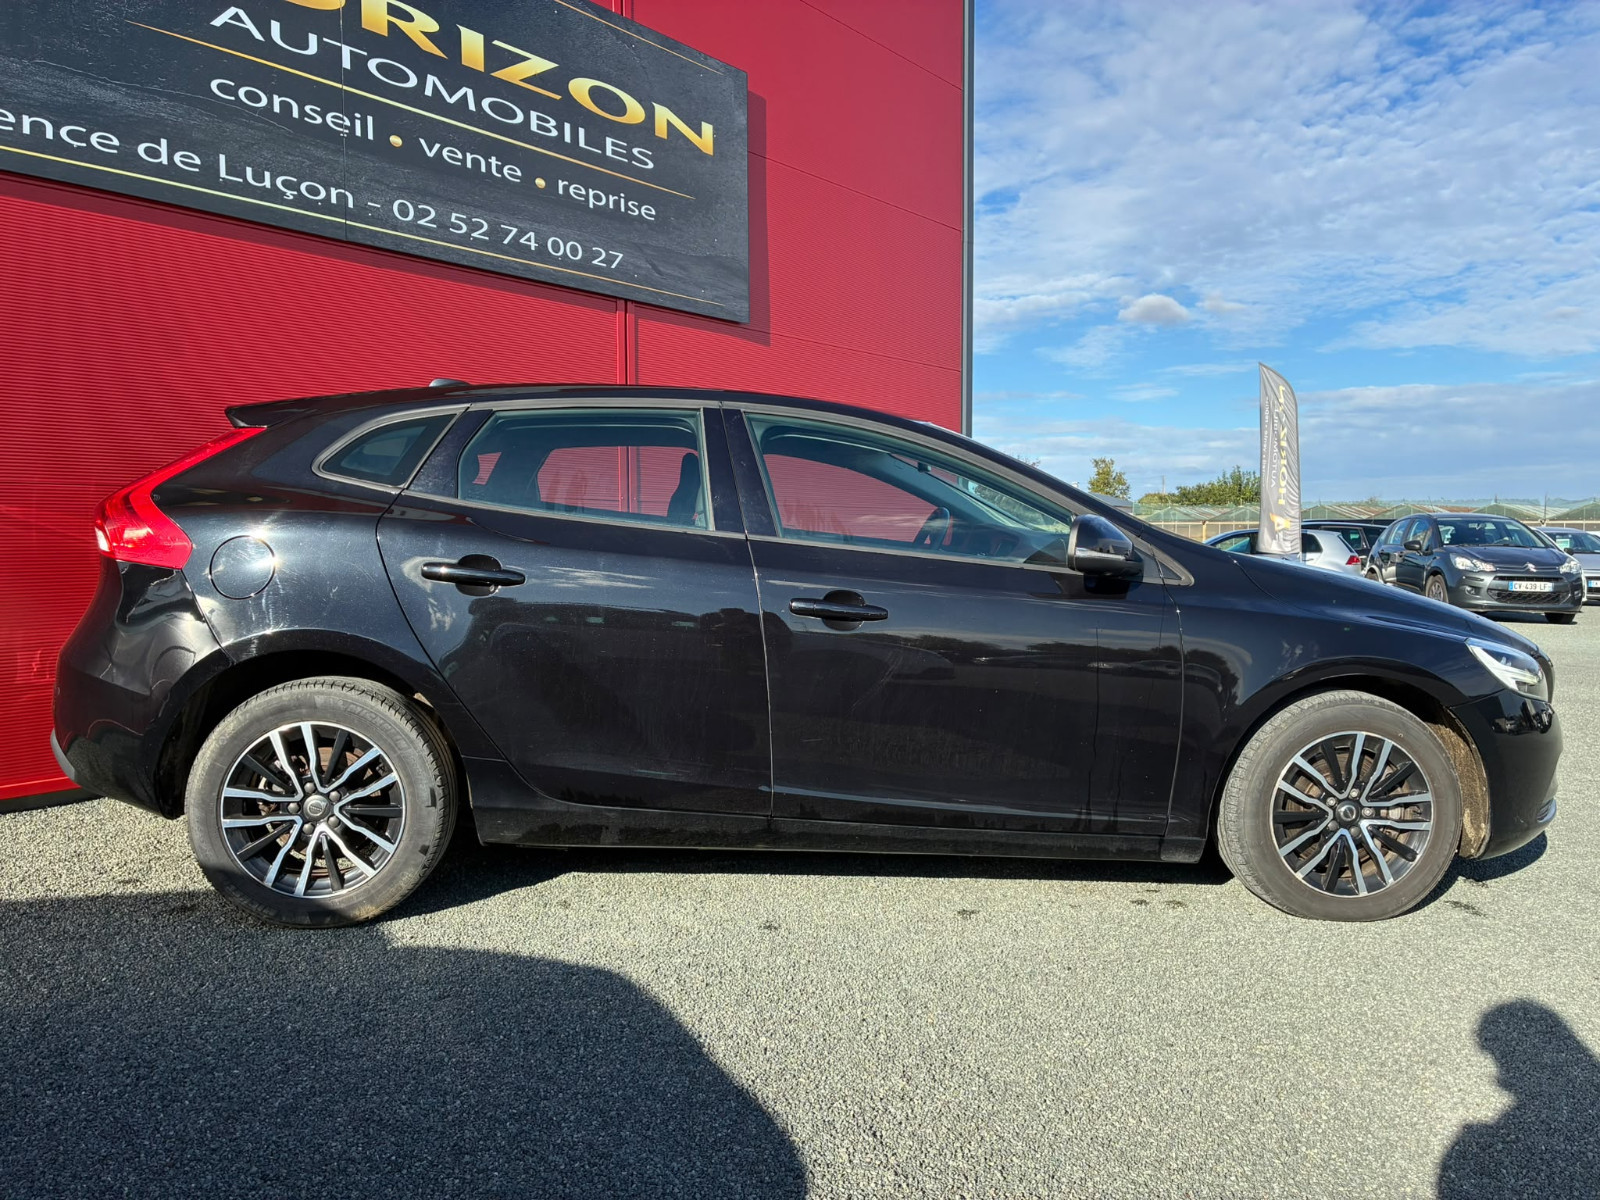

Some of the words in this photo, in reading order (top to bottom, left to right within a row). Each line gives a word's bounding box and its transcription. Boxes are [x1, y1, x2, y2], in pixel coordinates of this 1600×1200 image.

[210, 6, 654, 169] AUTOMOBILES
[210, 78, 374, 140] conseil
[419, 137, 522, 182] vente
[558, 178, 656, 221] reprise
[283, 0, 714, 156] RIZON
[137, 138, 201, 172] de
[218, 153, 354, 208] Luçon
[392, 199, 437, 228] 02
[449, 212, 489, 240] 52
[500, 224, 538, 250] 74
[546, 236, 583, 261] 00
[591, 246, 624, 269] 27
